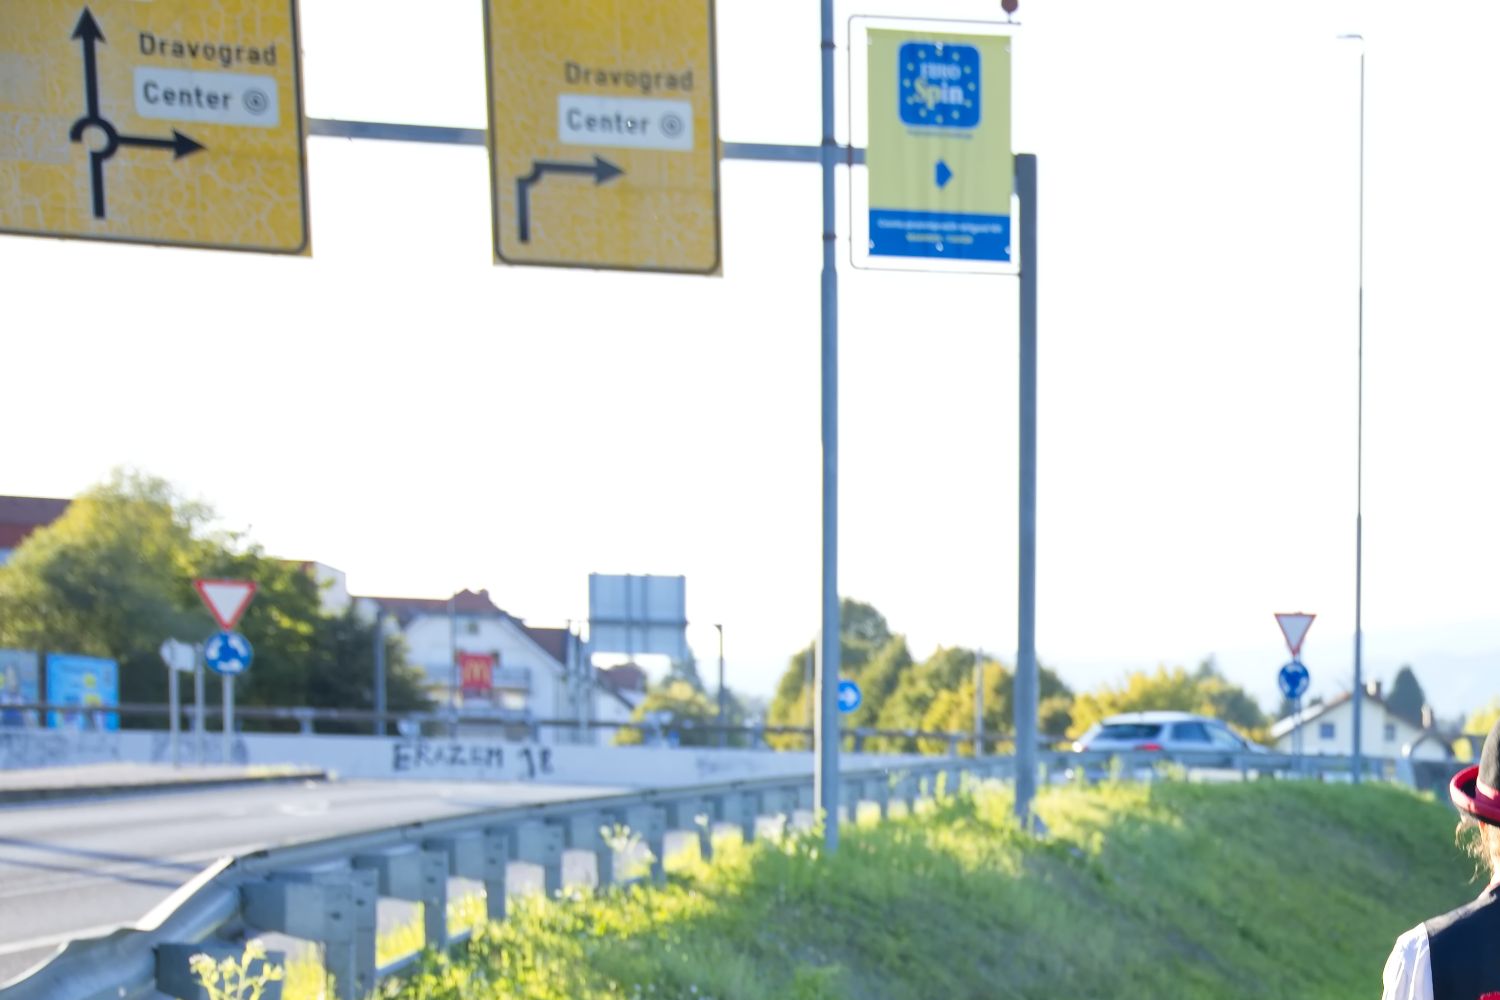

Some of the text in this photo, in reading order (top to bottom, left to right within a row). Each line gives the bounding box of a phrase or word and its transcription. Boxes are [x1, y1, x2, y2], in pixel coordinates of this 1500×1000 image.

[139, 31, 277, 67] Dravograd
[565, 60, 694, 95] Dravograd
[143, 79, 231, 110] Center
[566, 107, 649, 134] Center
